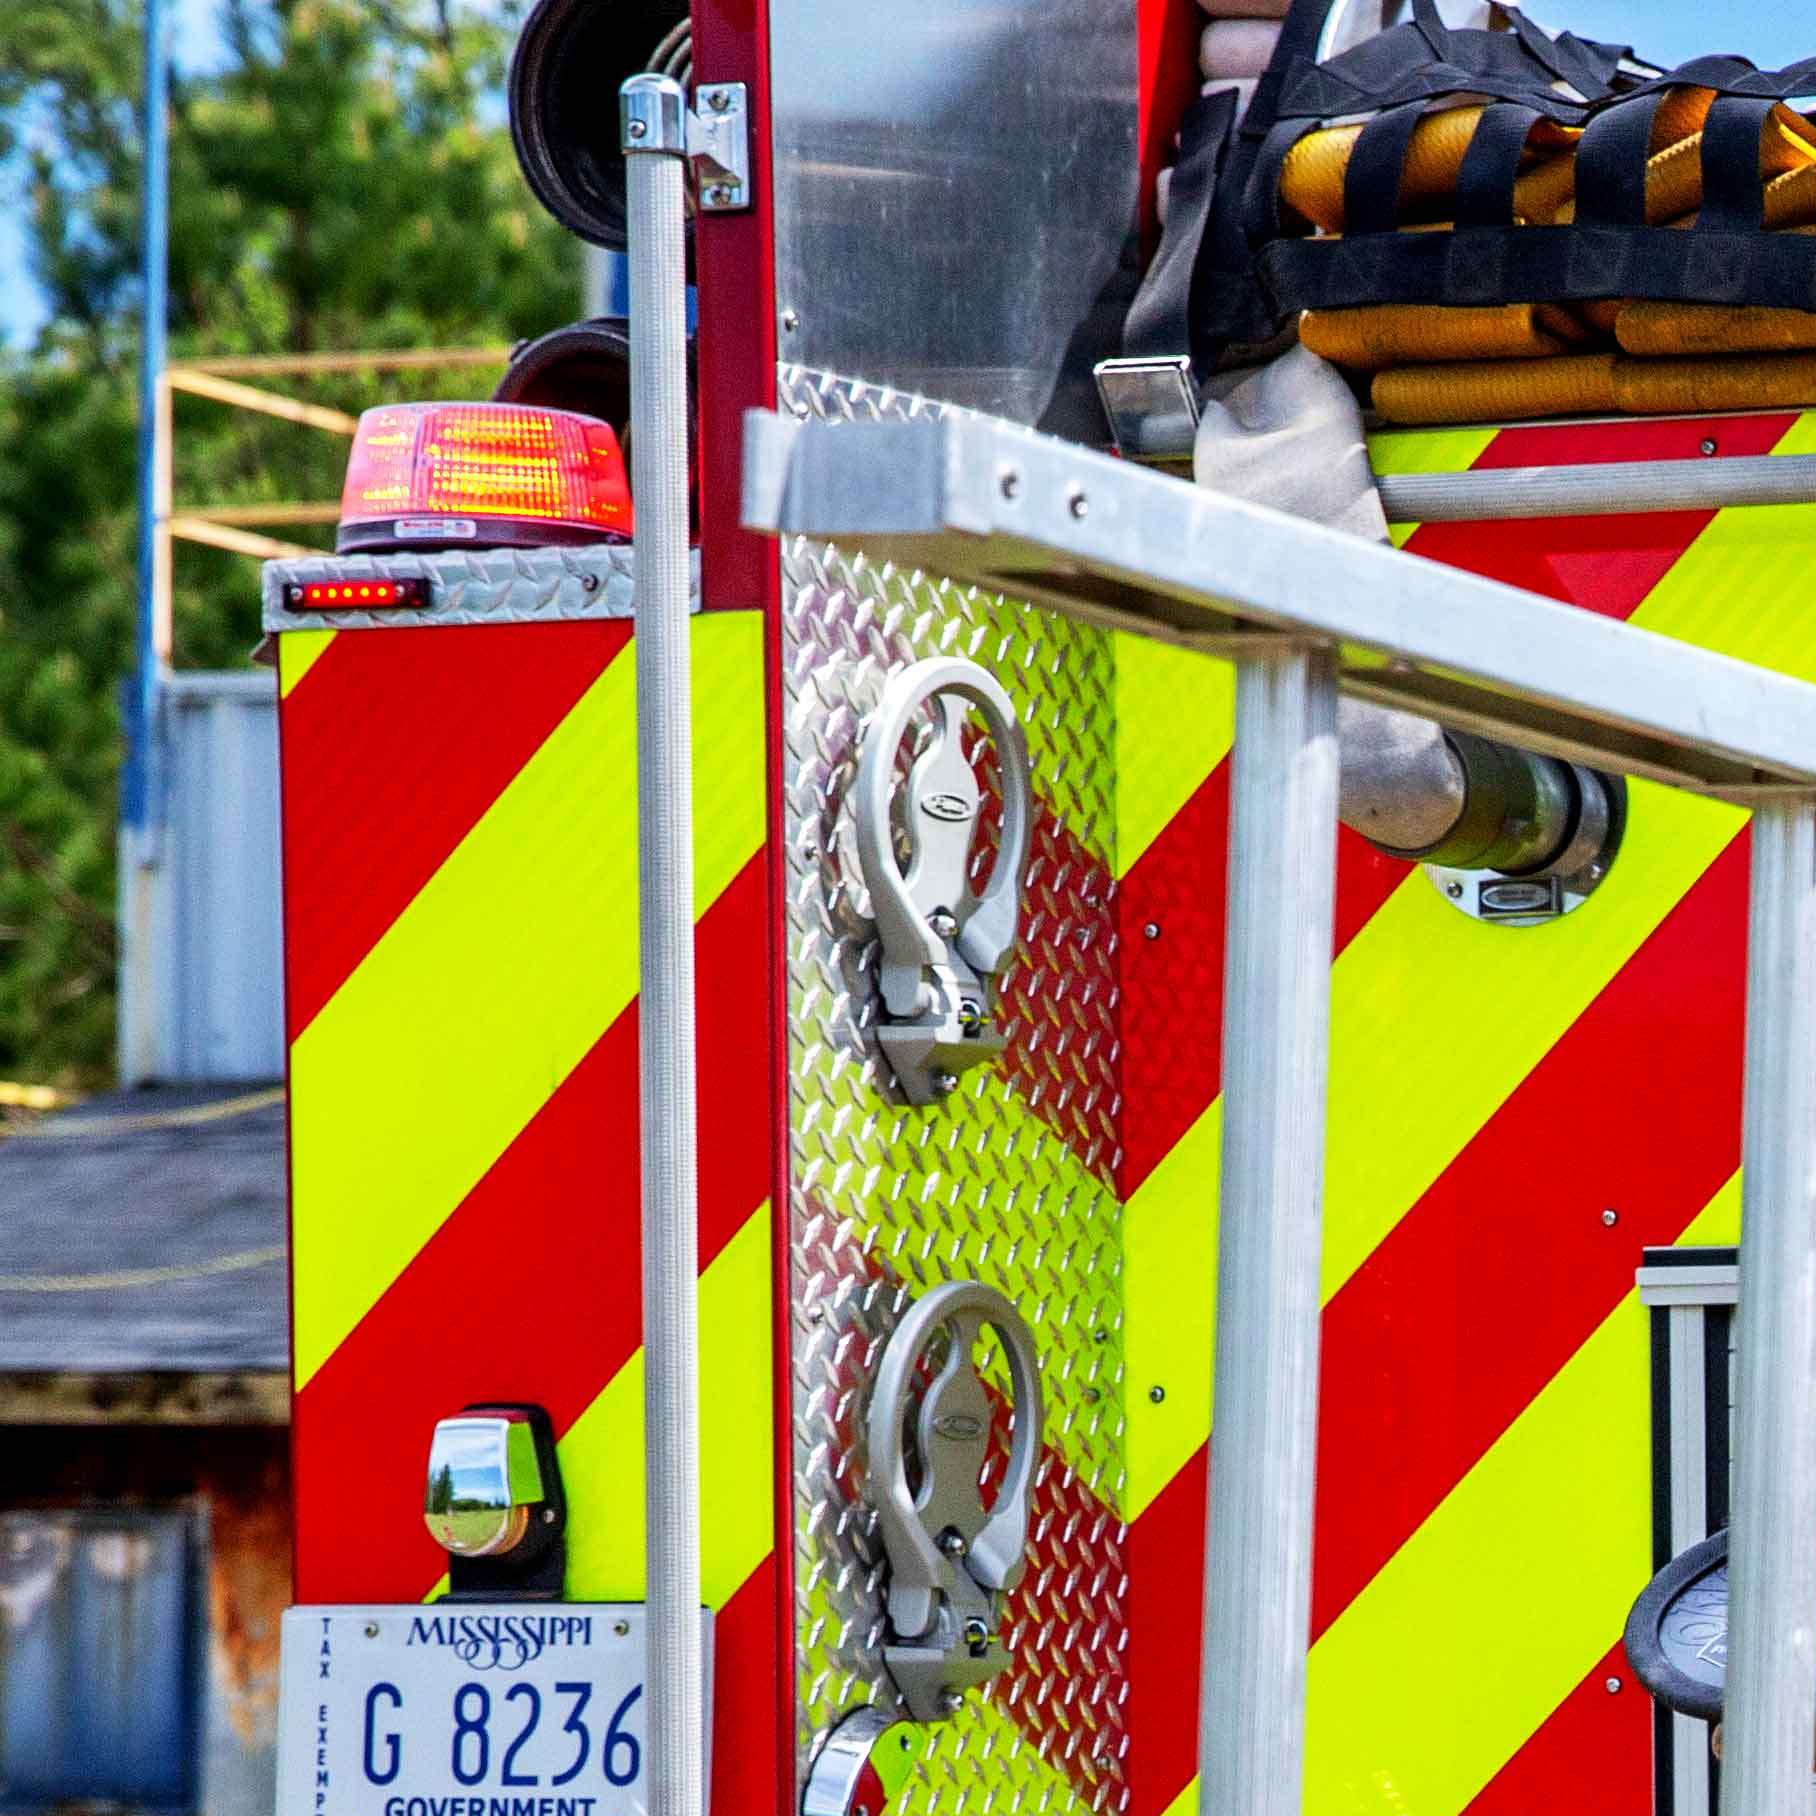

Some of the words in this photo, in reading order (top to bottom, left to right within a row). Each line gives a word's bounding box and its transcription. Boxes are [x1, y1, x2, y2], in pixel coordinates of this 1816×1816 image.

[319, 1617, 333, 1680] TAX
[406, 1615, 593, 1671] MISSISSIPPI
[362, 1681, 403, 1787] G
[451, 1681, 644, 1788] 8236
